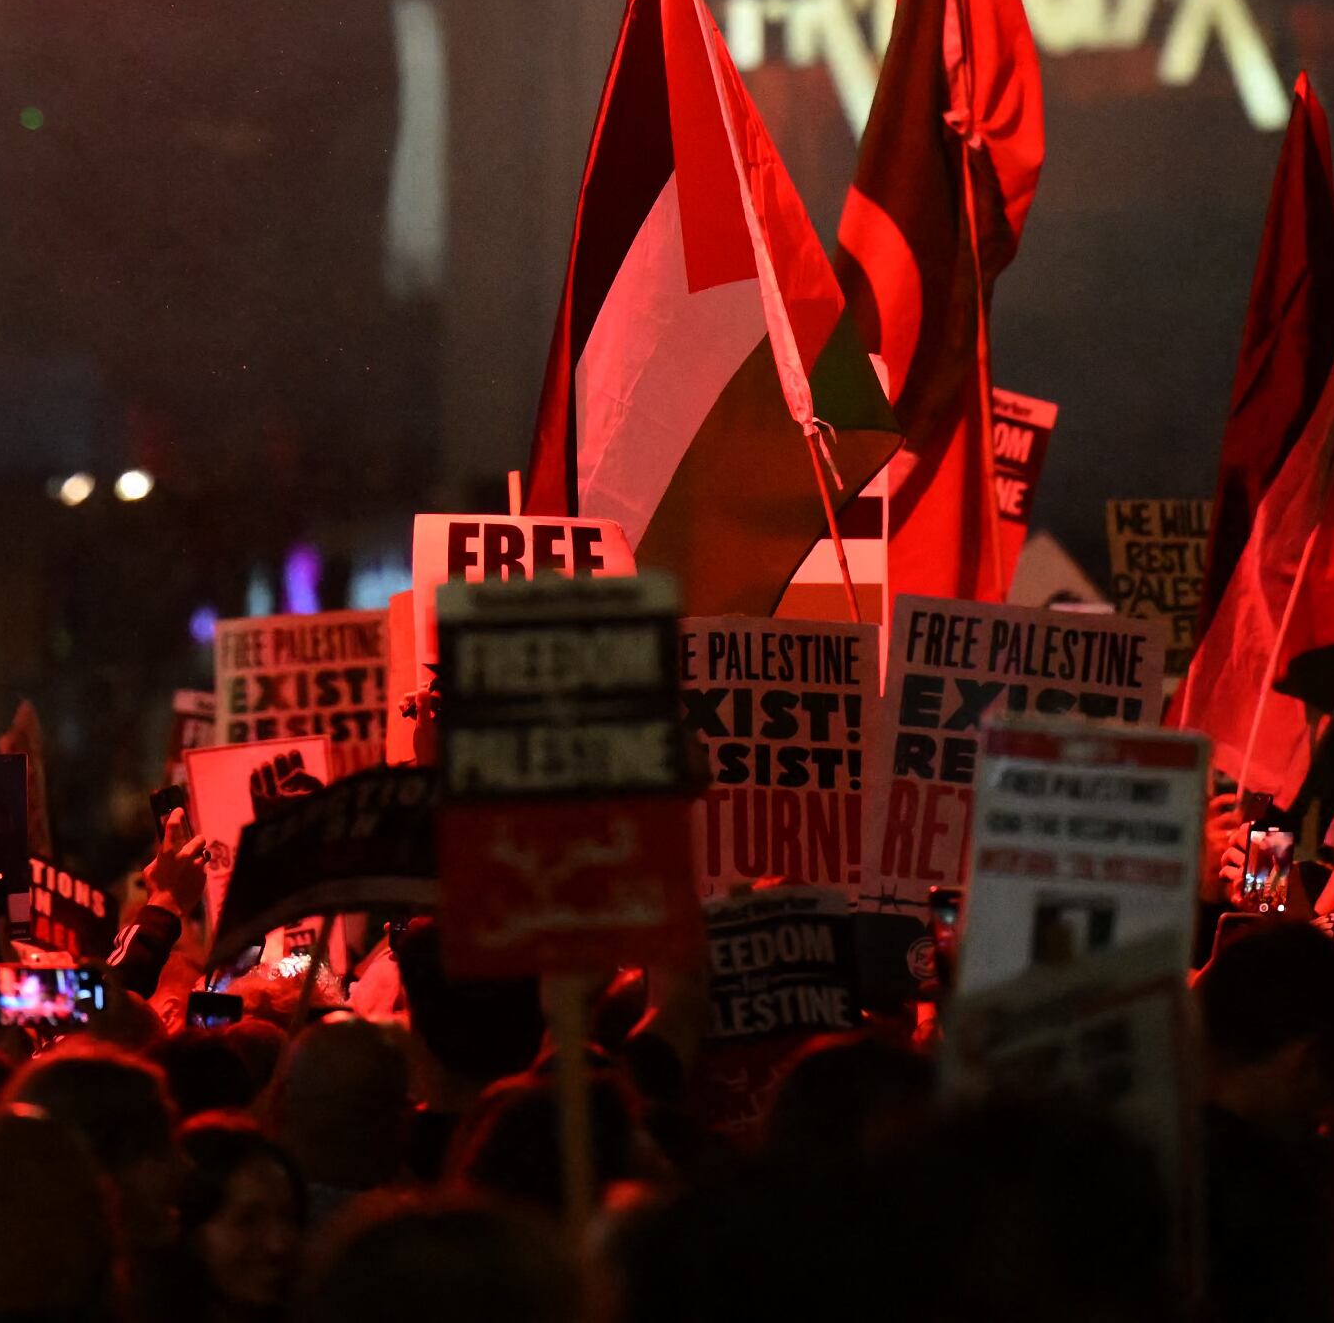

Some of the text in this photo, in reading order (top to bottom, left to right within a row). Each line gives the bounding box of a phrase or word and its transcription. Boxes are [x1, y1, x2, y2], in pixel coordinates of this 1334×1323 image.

[448, 522, 604, 583] FREE
[1124, 540, 1188, 575] REST
[1113, 574, 1205, 617] PALES
[272, 620, 383, 665] PALESTINE
[707, 631, 861, 686] PALESTINE
[906, 610, 983, 670] FREE
[988, 618, 1147, 689] PALESTINE
[229, 666, 386, 714] EXIST!
[679, 688, 863, 744] XIST!
[703, 742, 863, 791] SIST!
[703, 788, 863, 885] TURN!
[28, 857, 107, 919] TIONS
[712, 923, 837, 976] EEDOM
[713, 985, 855, 1039] LESTINE
